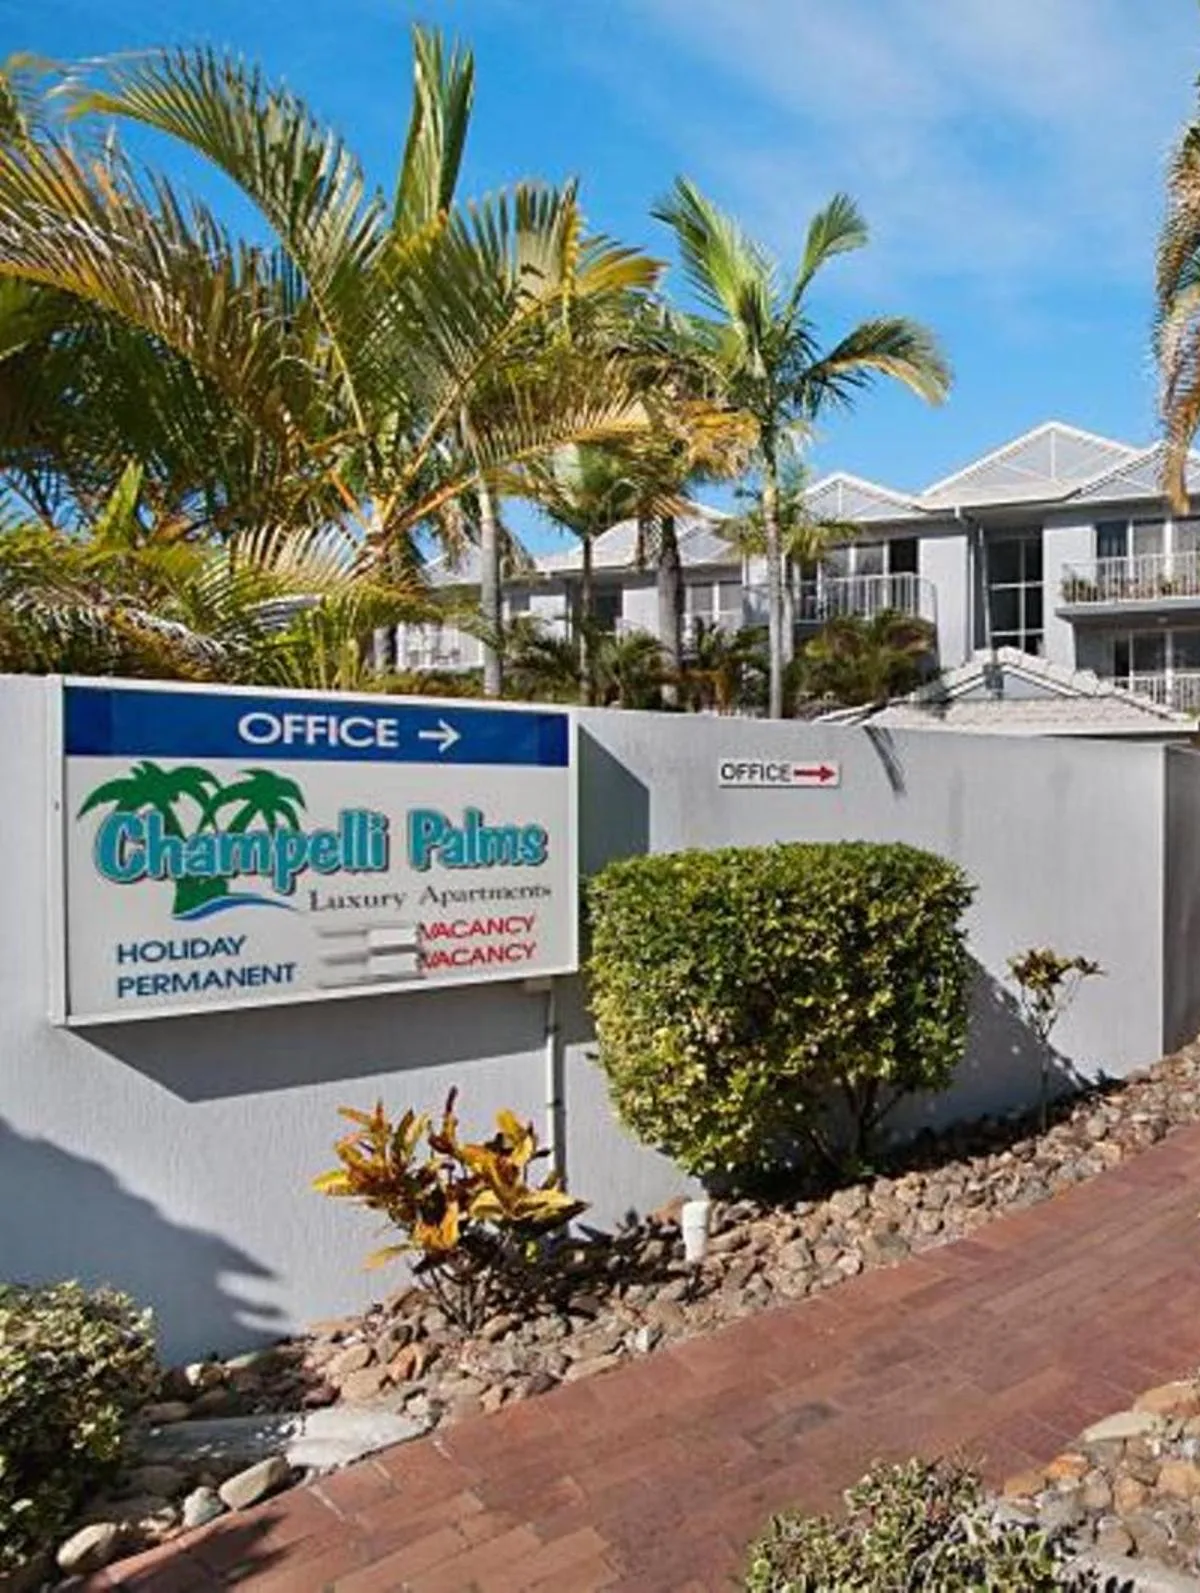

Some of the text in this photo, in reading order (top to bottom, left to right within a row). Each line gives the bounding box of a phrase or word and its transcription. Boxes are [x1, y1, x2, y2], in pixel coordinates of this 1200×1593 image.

[238, 711, 399, 748] OFFICE
[721, 762, 791, 782] OFFICE
[93, 805, 550, 896] Champelli Palms
[309, 884, 551, 912] Luxury Apartments
[117, 914, 536, 964] HOLIDAY VACANCY
[117, 942, 537, 998] PERMANENT VACANCY
